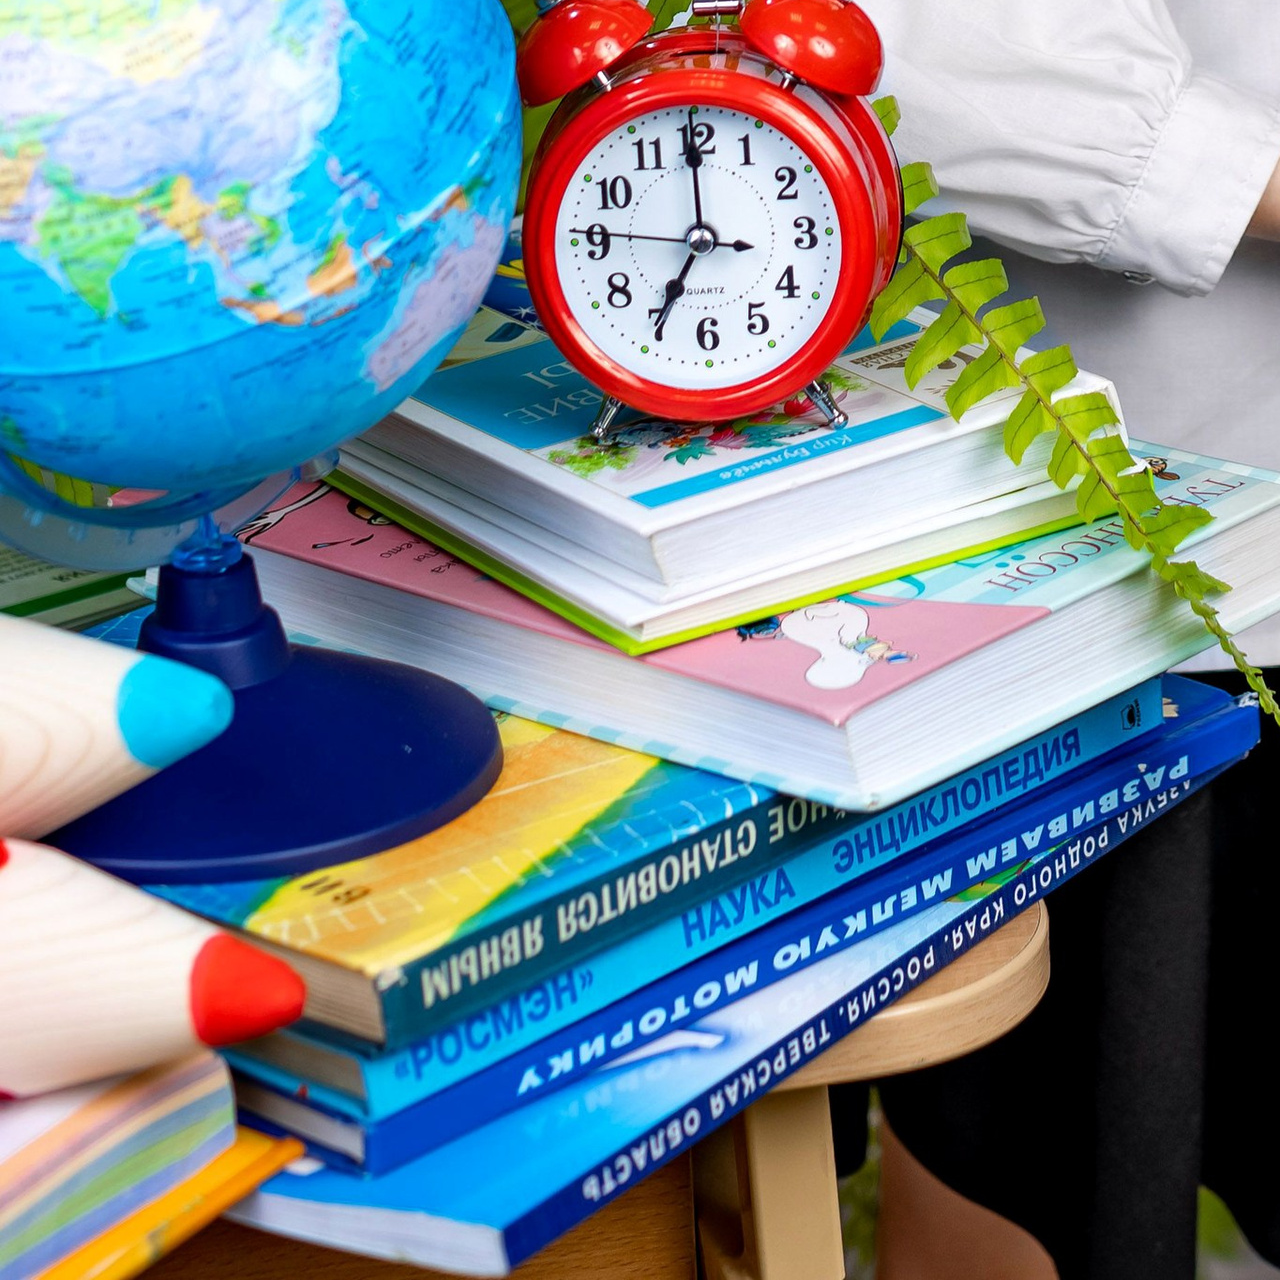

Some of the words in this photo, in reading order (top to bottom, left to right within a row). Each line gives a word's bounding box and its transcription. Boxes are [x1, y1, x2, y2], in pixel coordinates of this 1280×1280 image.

[632, 137, 667, 171] 11
[677, 122, 716, 156] 12
[738, 135, 756, 167] 1
[596, 175, 632, 210] 10
[774, 166, 799, 200] 2
[586, 224, 611, 260] 9
[793, 217, 818, 249] 3
[607, 272, 632, 308] 8
[686, 286, 726, 296] QUARTZ
[775, 265, 800, 299] 4
[648, 308, 668, 341] 7
[696, 317, 720, 351] 6
[747, 302, 770, 335] 5
[813, 434, 852, 450] Кир
[966, 755, 1189, 880] РАЗВИВАЕМ
[557, 820, 757, 943] СТАНОВИТСЯ
[1014, 826, 1108, 906] РОДНОГО
[394, 968, 594, 1081] «РОСМЭН»
[680, 866, 796, 949] НАУКА
[832, 728, 1081, 872] ЭНЦИКЛОПЕДИЯ
[773, 867, 953, 971] МЕЛКУЮ
[421, 914, 544, 1009] ЯВНЫМ
[517, 960, 759, 1095] МОТОРИКУ
[710, 1018, 830, 1120] ТВЕРСКАЯ
[584, 1108, 700, 1204] ОБЛАСТЬ
